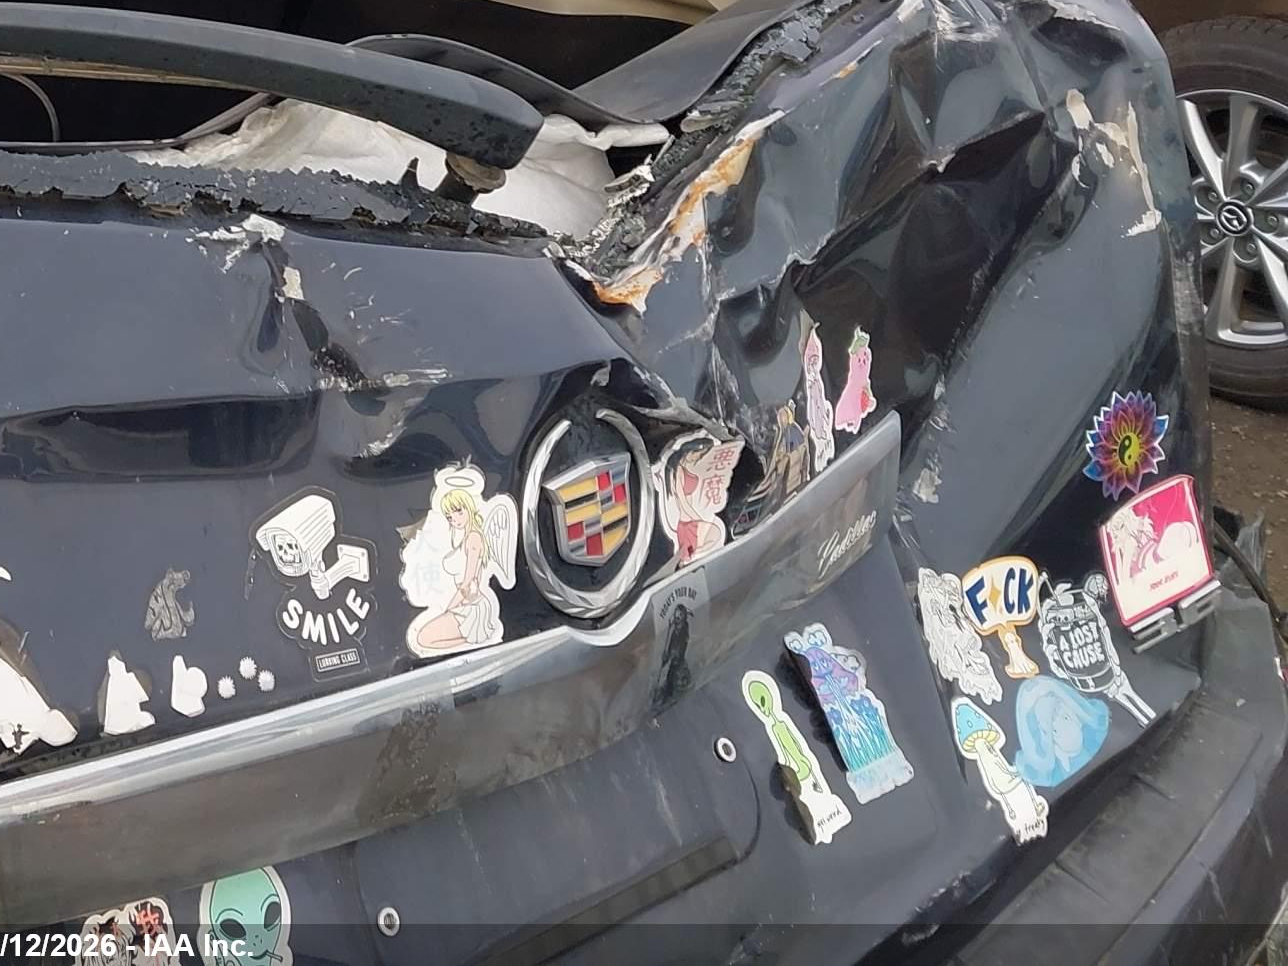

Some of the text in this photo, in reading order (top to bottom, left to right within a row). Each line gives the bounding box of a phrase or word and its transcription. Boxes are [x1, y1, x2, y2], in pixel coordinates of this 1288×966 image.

[282, 588, 370, 646] SMILE
[1060, 622, 1099, 652] A LOST
[341, 651, 358, 664] CLASS
[1062, 642, 1106, 670] CAUSE
